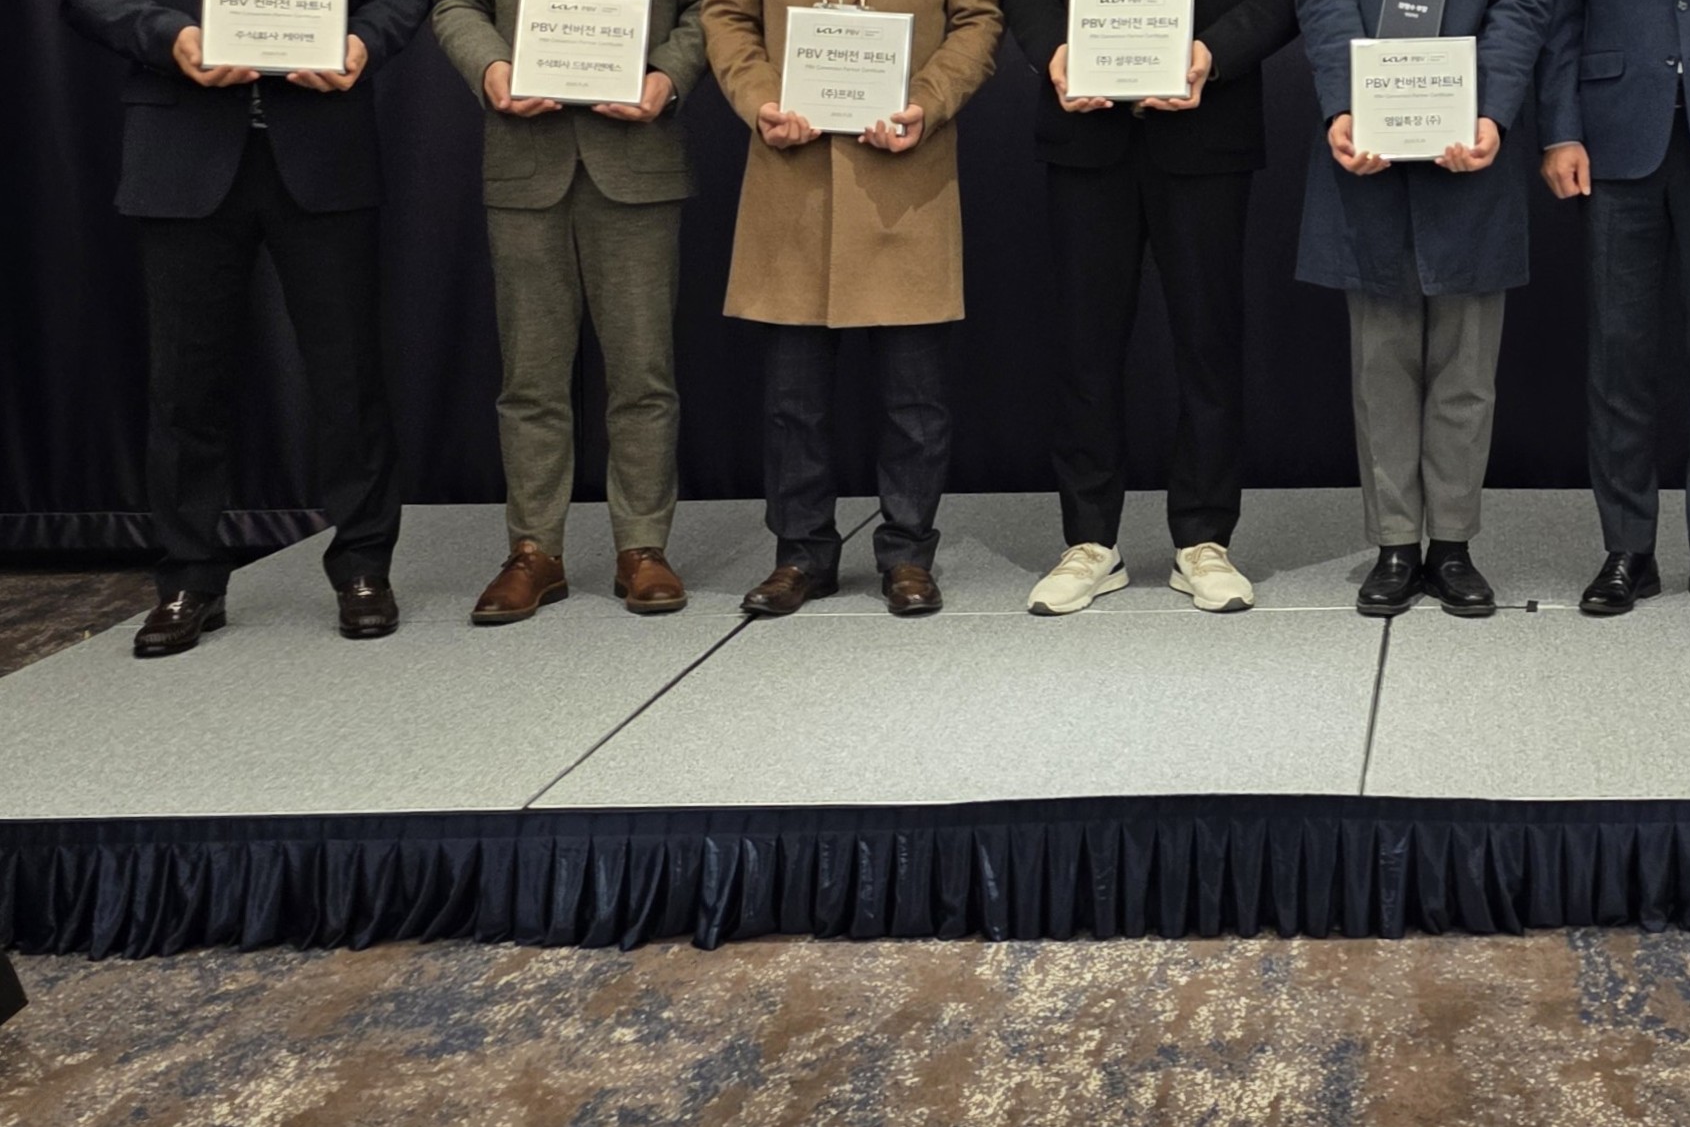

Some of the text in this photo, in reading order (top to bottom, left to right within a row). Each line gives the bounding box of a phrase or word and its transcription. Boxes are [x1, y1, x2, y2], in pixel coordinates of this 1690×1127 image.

[295, 0, 332, 11] 파트너
[1081, 17, 1179, 29] PBV 컨버전 파트너
[530, 22, 634, 39] PBV 컨버전 파트너
[797, 48, 896, 64] PBV 컨버전 파트너
[1096, 55, 1112, 65] (주)
[1365, 75, 1463, 89] PBV 컨버전 파트너
[1426, 115, 1441, 126] (주)
